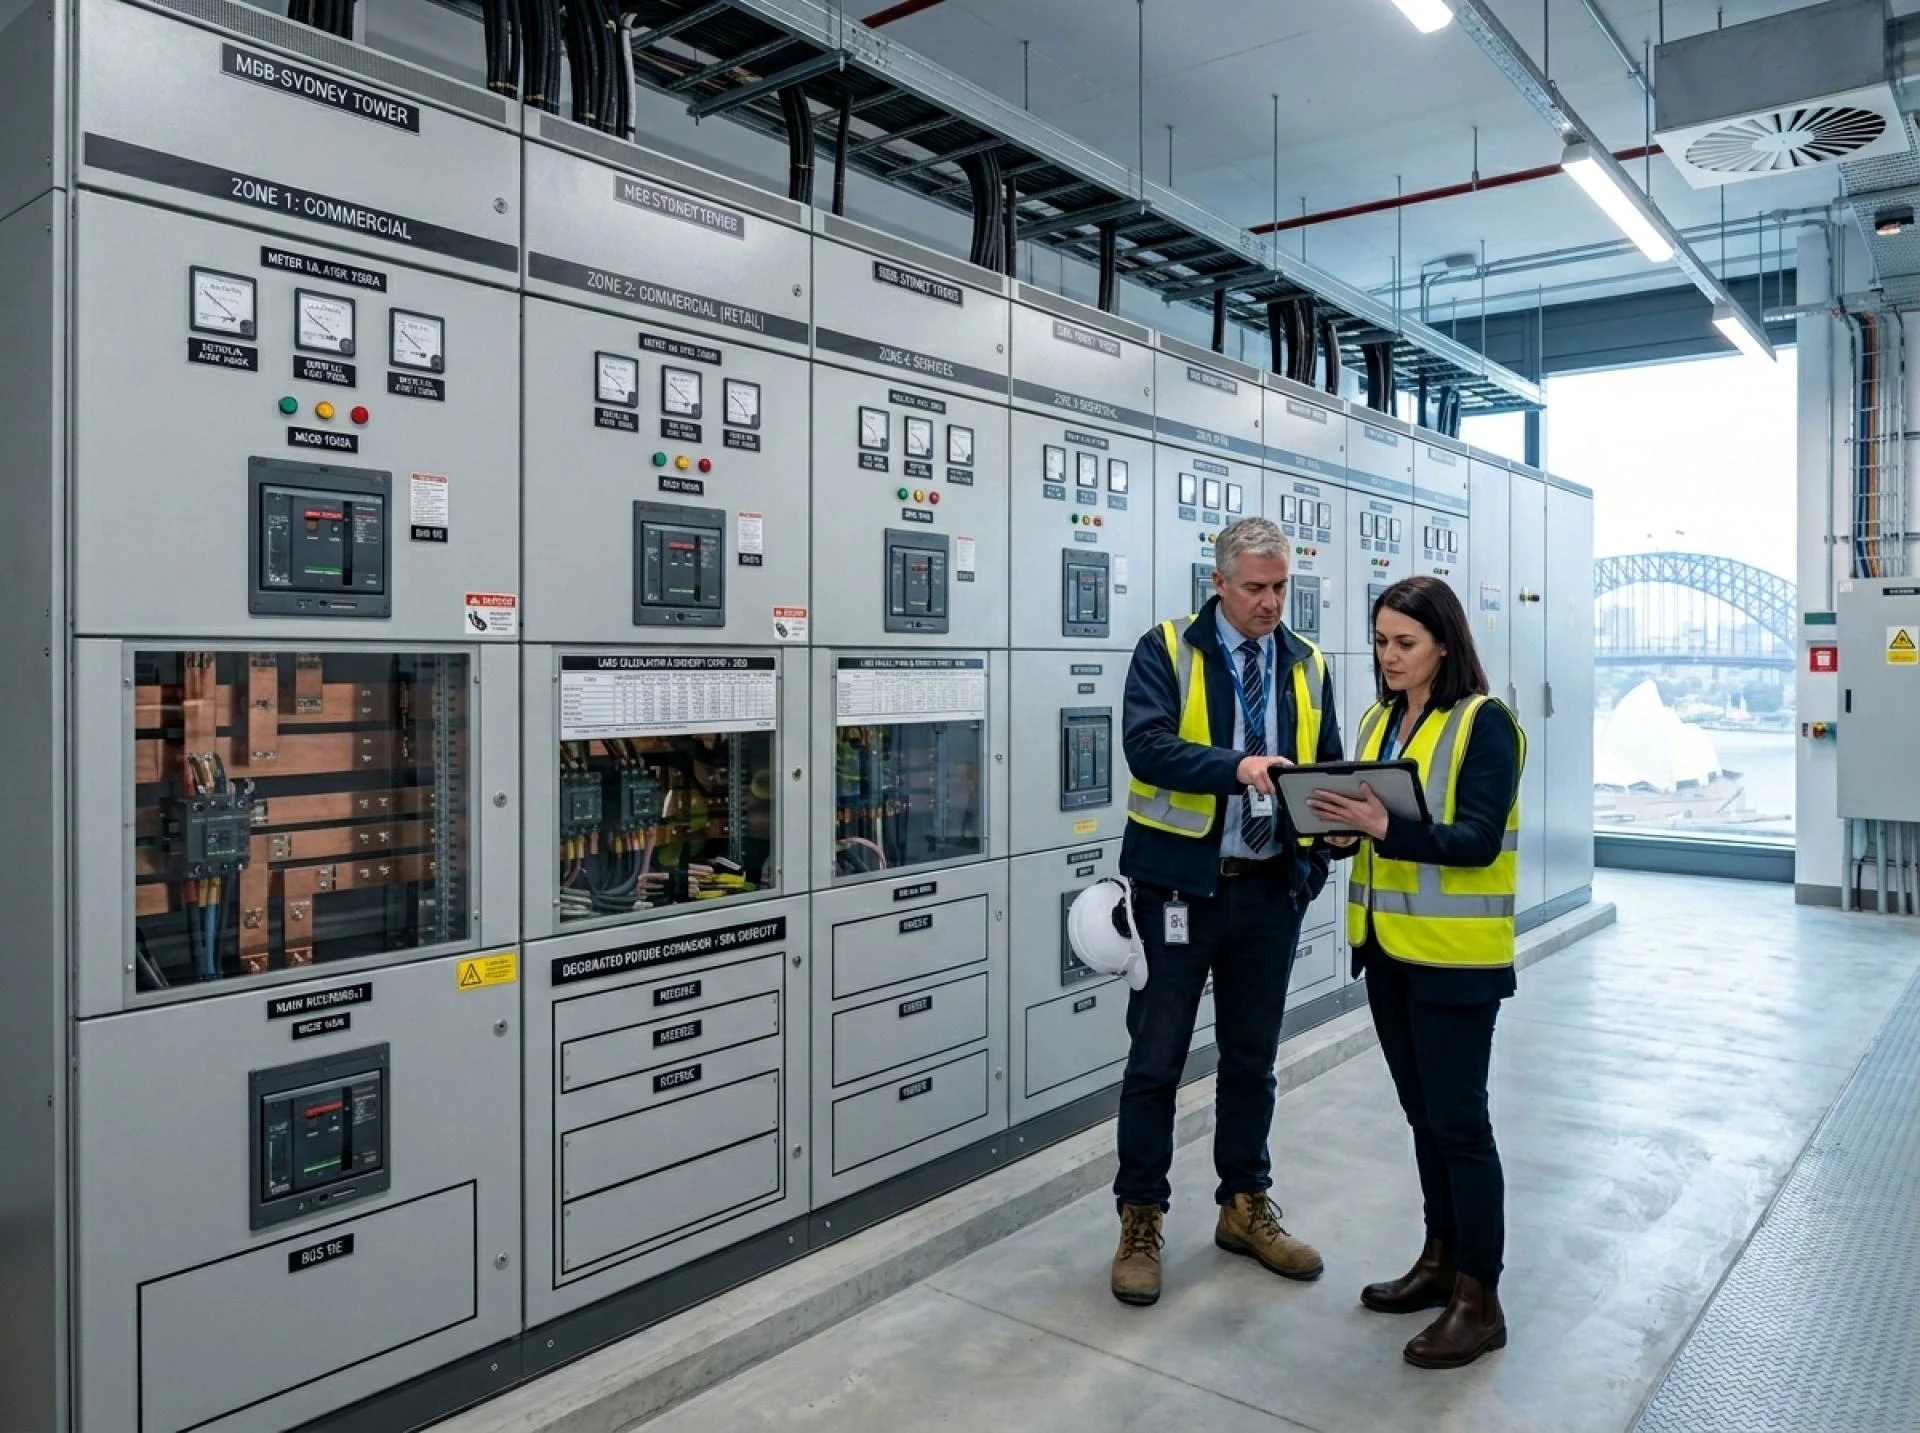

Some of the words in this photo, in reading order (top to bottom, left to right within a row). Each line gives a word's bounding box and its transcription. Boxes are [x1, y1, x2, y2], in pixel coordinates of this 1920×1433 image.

[353, 92, 409, 124] TOWER
[232, 178, 278, 205] ZONE
[285, 193, 300, 211] 1:
[304, 197, 412, 240] COMMERCIAL
[587, 271, 621, 293] ZONE
